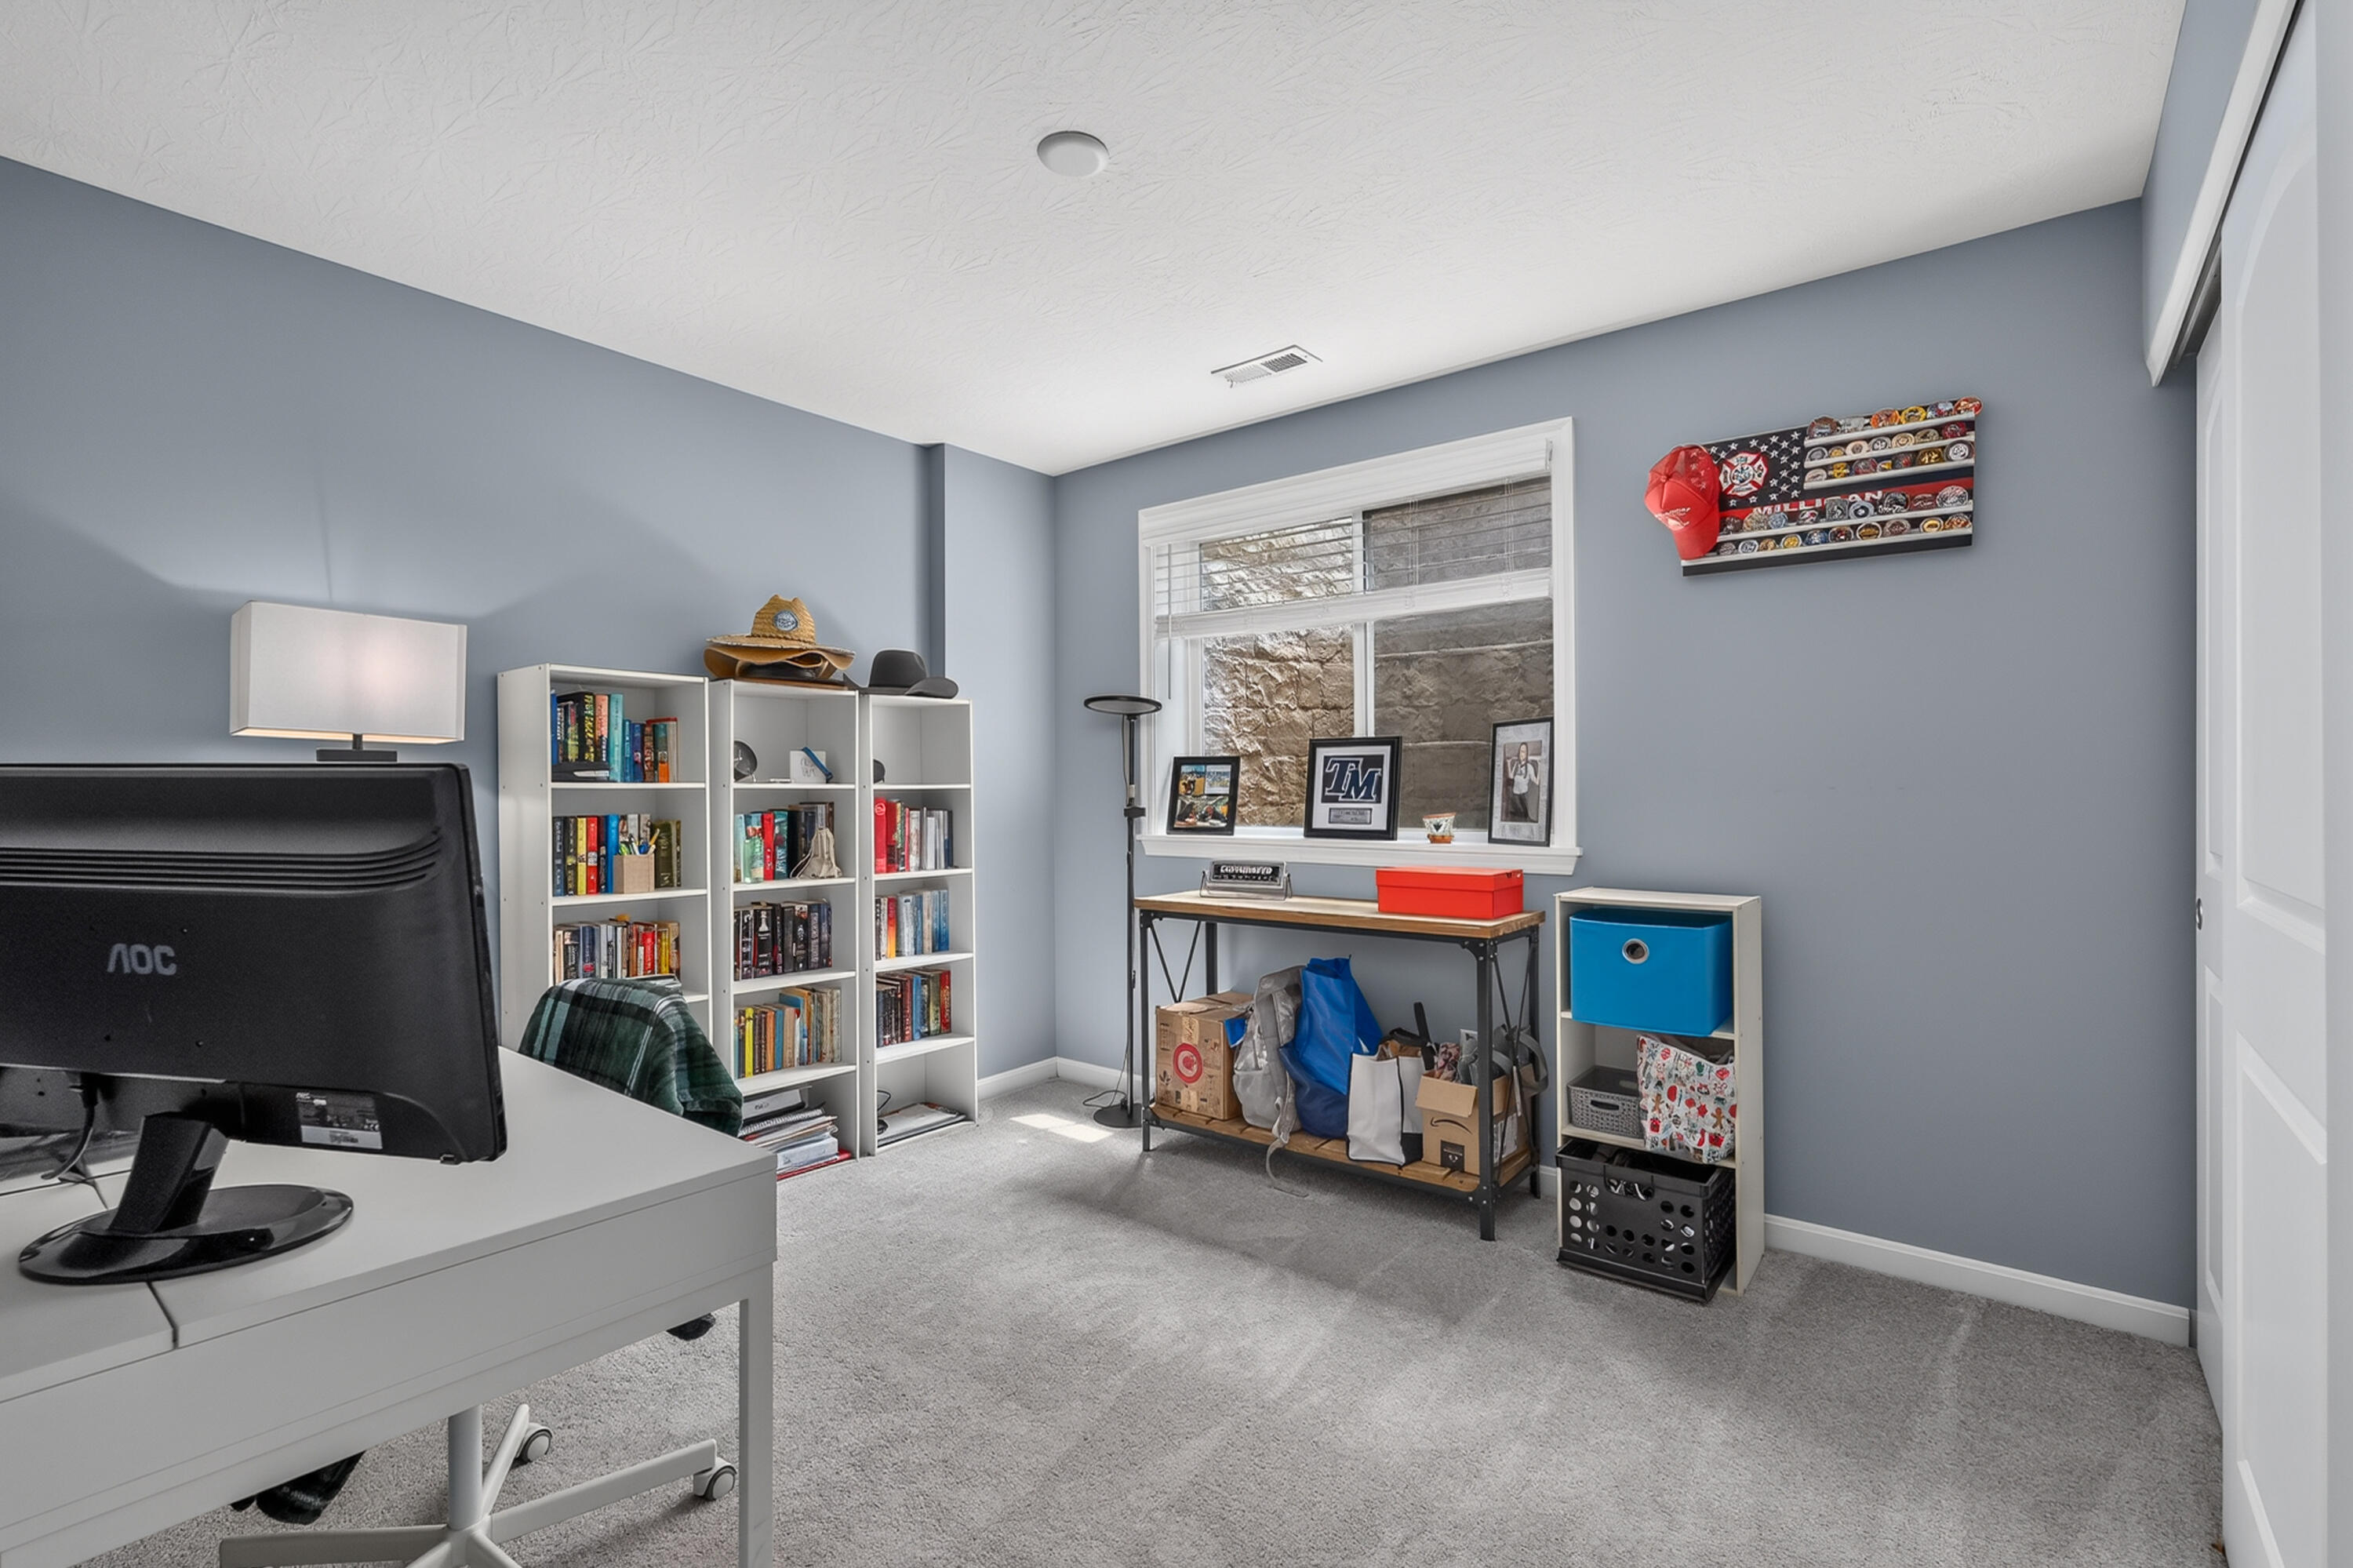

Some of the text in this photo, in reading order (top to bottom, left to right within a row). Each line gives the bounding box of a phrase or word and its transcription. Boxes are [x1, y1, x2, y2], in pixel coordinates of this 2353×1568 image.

[1753, 490, 1883, 515] MILLIAN
[1325, 758, 1382, 802] TM
[107, 943, 177, 976] AOC
